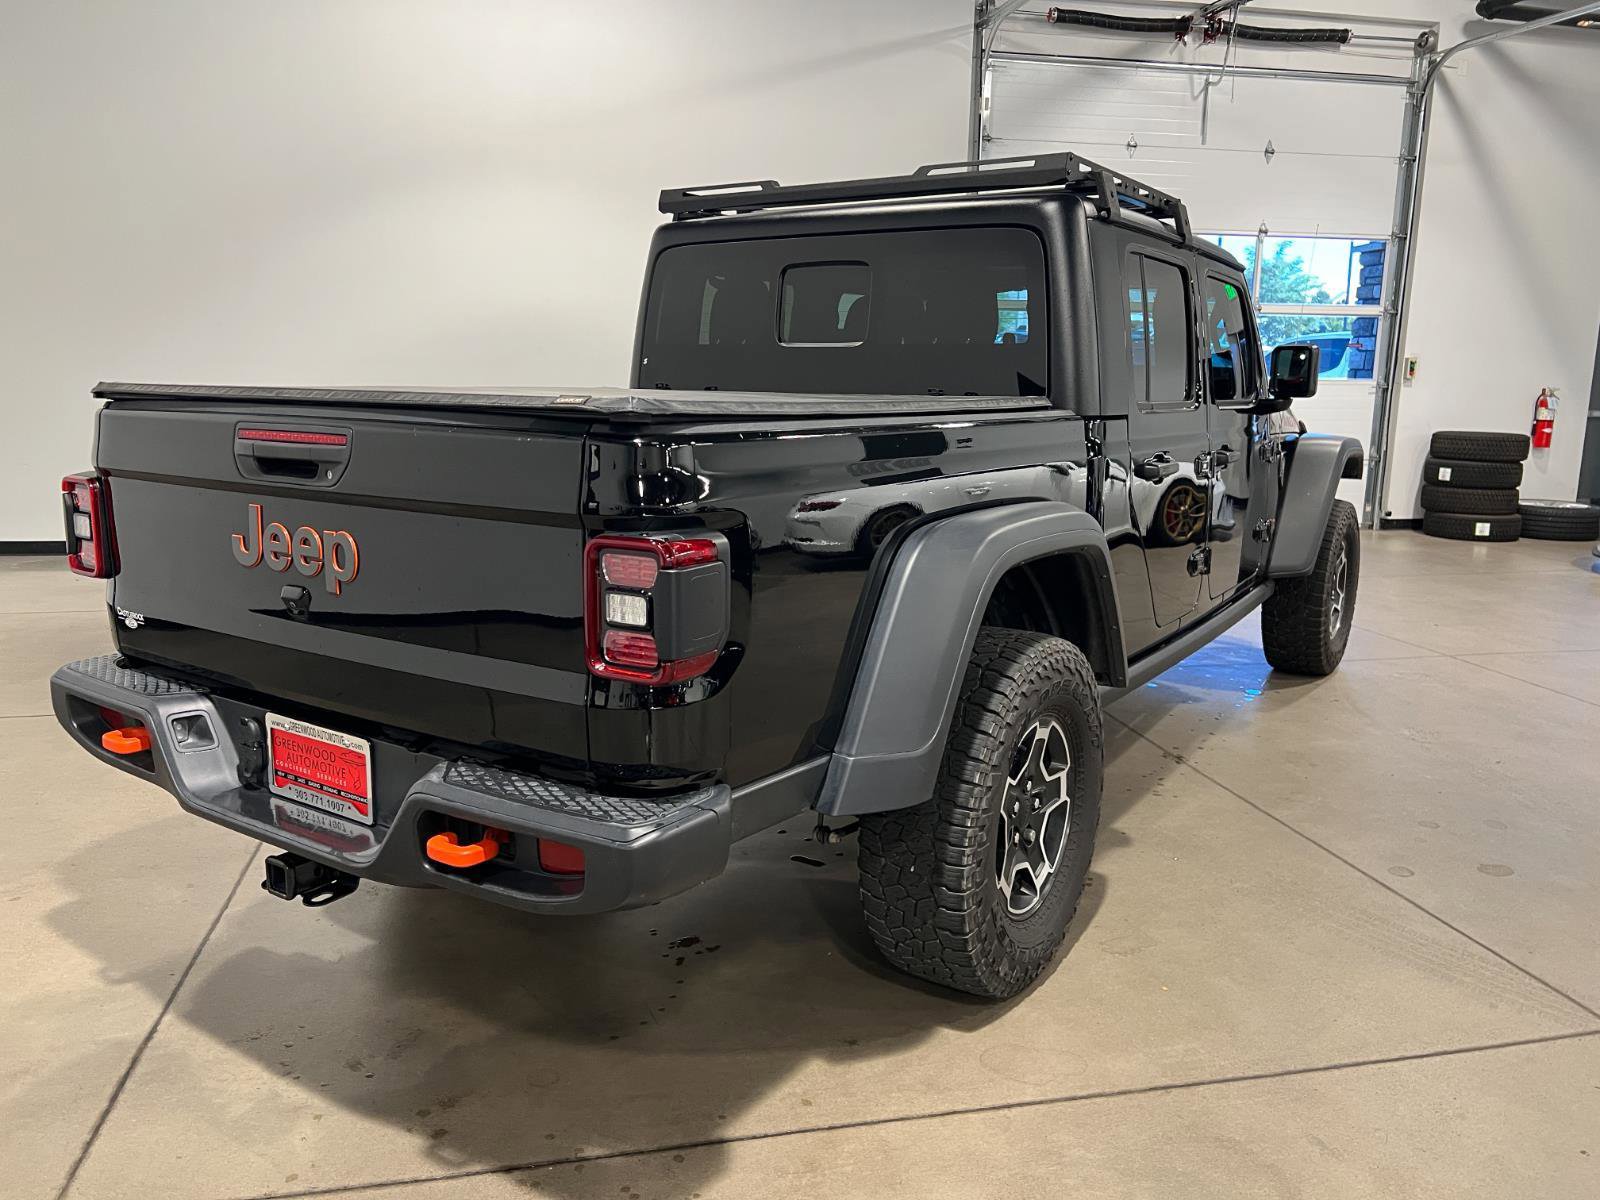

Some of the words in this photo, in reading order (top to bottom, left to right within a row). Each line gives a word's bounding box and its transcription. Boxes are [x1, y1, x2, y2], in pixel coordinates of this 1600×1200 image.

[231, 503, 359, 596] Jeep
[274, 735, 336, 762] GREENWOOD
[286, 752, 346, 778] AUTOMOTIVE
[316, 772, 347, 787] SERVICES
[294, 788, 345, 813] 303.771.1007
